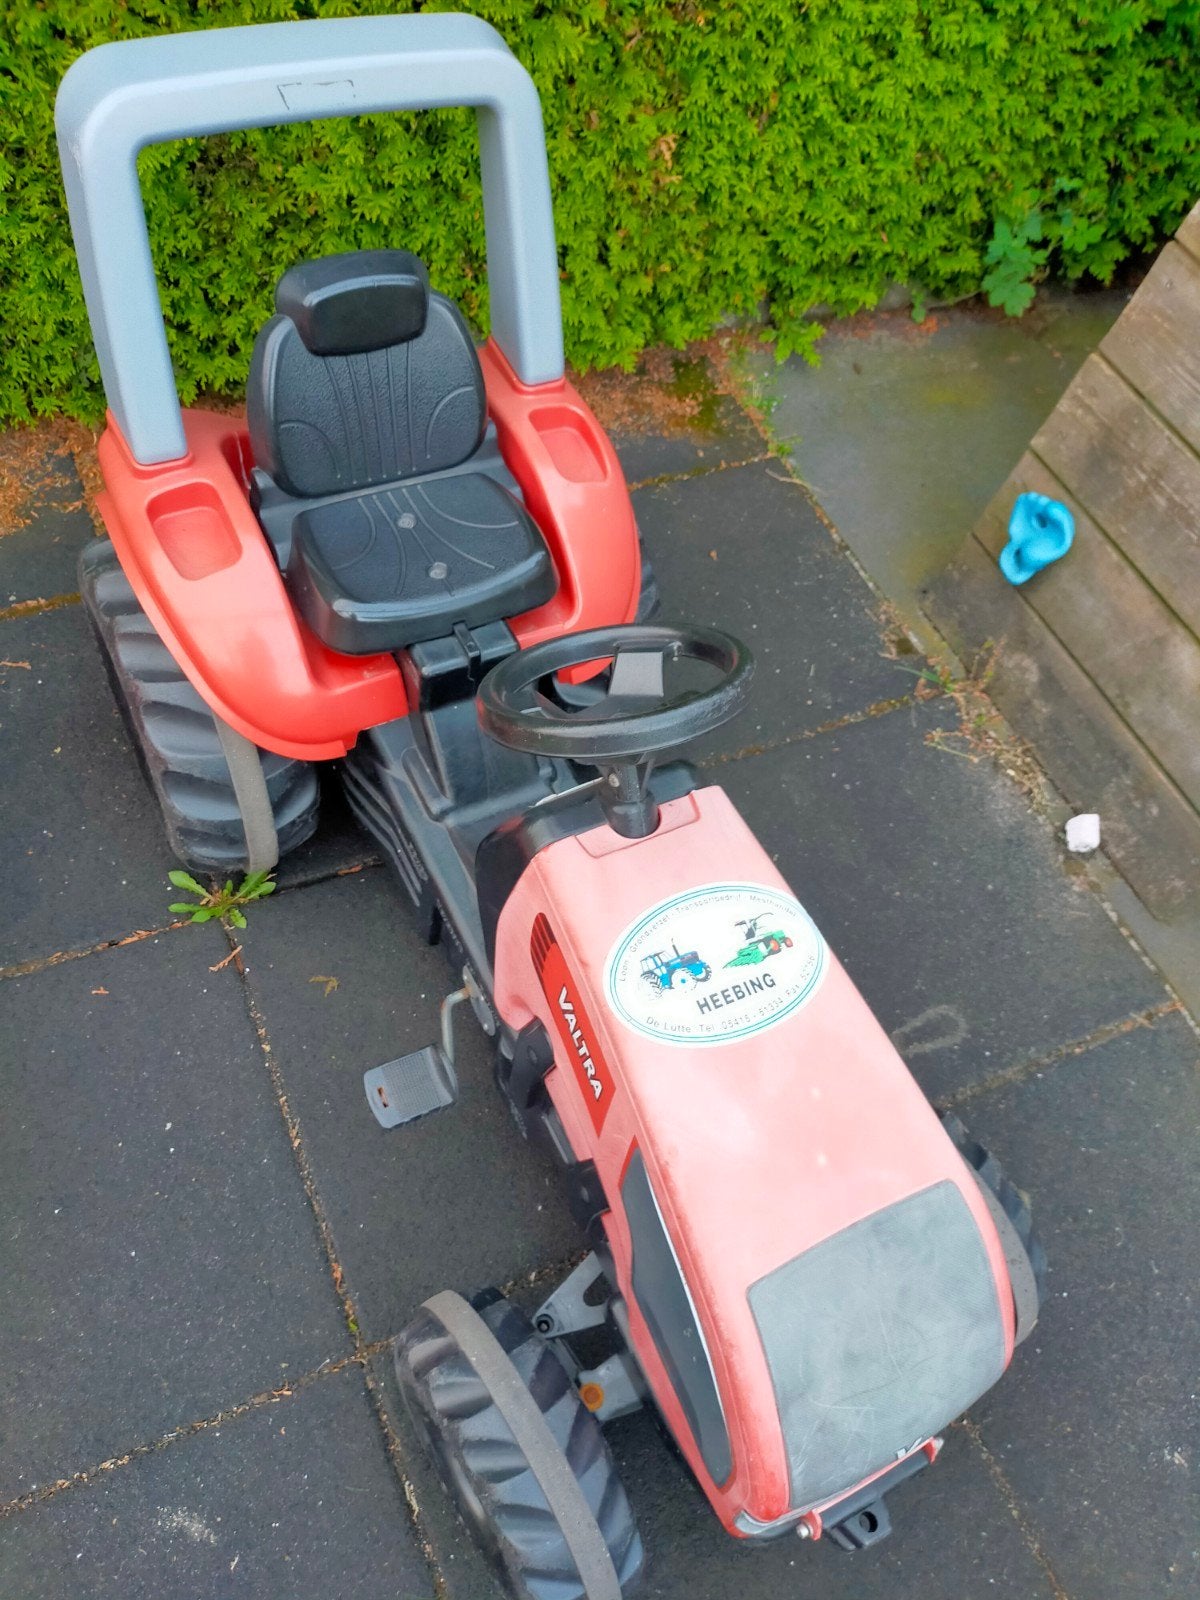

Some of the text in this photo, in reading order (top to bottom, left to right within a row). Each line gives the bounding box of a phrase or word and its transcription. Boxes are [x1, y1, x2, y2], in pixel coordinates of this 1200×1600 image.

[696, 973, 777, 1015] HEEBING
[559, 984, 603, 1102] VALTRA
[646, 1016, 660, 1028] De
